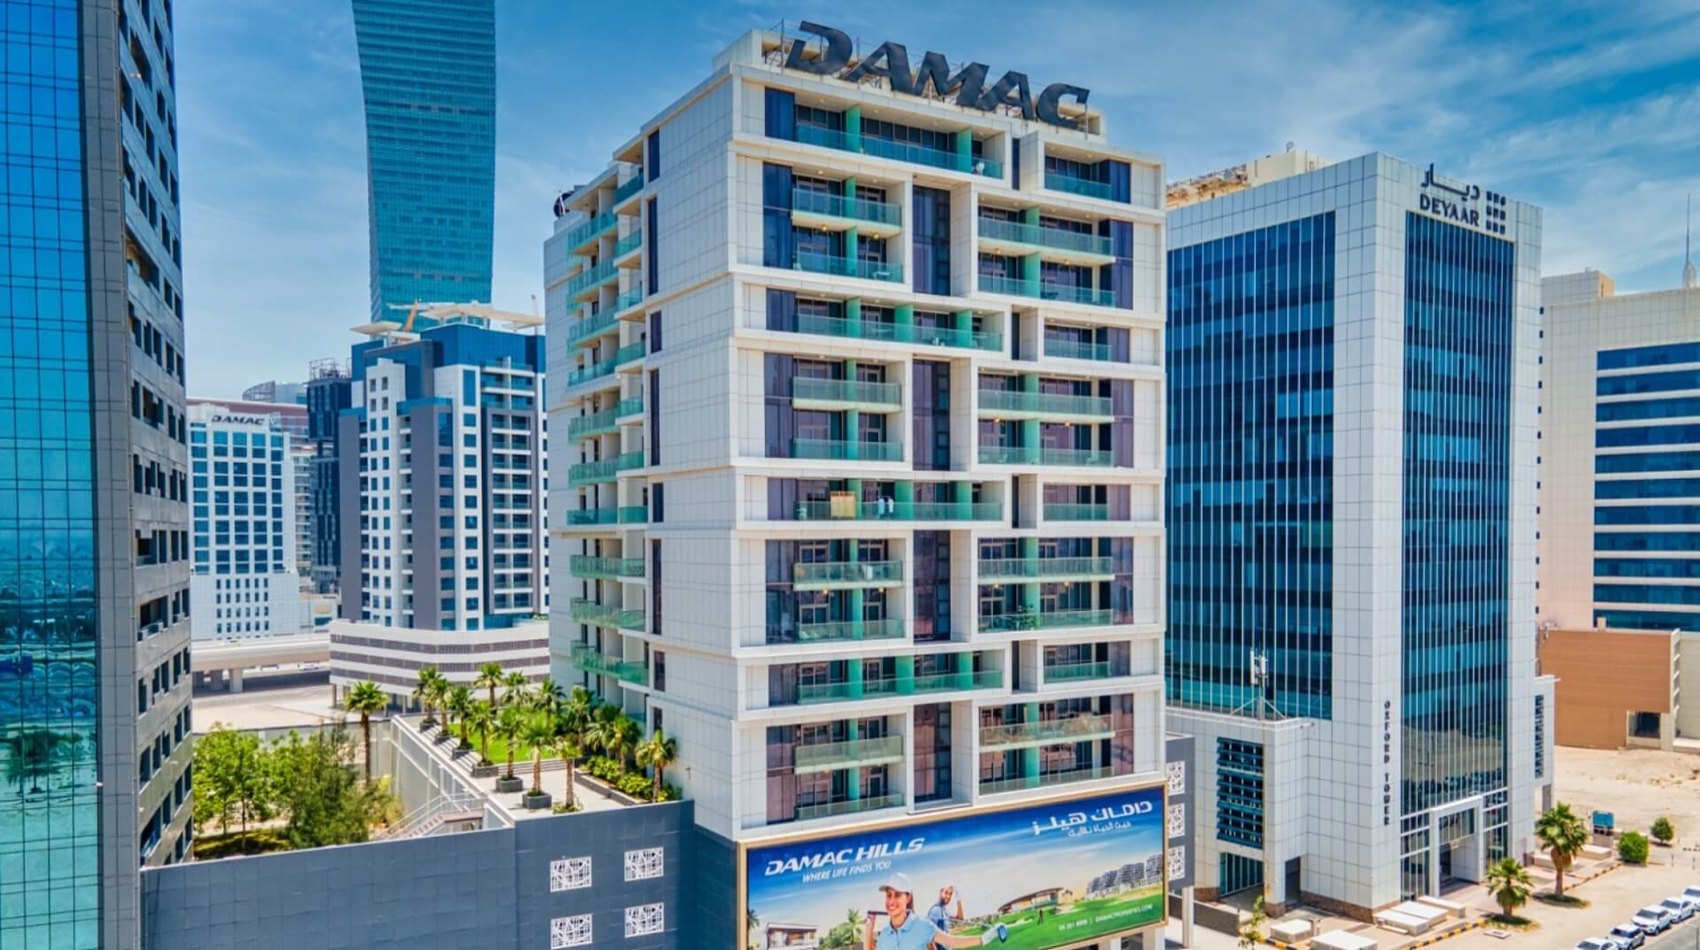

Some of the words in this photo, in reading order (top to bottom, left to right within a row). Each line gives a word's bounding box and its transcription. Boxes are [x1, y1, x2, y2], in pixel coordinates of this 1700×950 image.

[785, 20, 1090, 129] DAMAC
[1420, 193, 1479, 227] DEYAAR
[212, 415, 265, 425] DAMAC
[1091, 801, 1152, 821] داماك
[1383, 773, 1391, 826] TOWER
[1032, 812, 1087, 835] هيلز
[765, 849, 853, 876] DAMAC
[855, 838, 925, 861] HILLS
[802, 870, 831, 883] WHERE
[832, 867, 848, 878] LIFE
[849, 864, 873, 875] FINDS
[874, 860, 892, 871] YOU
